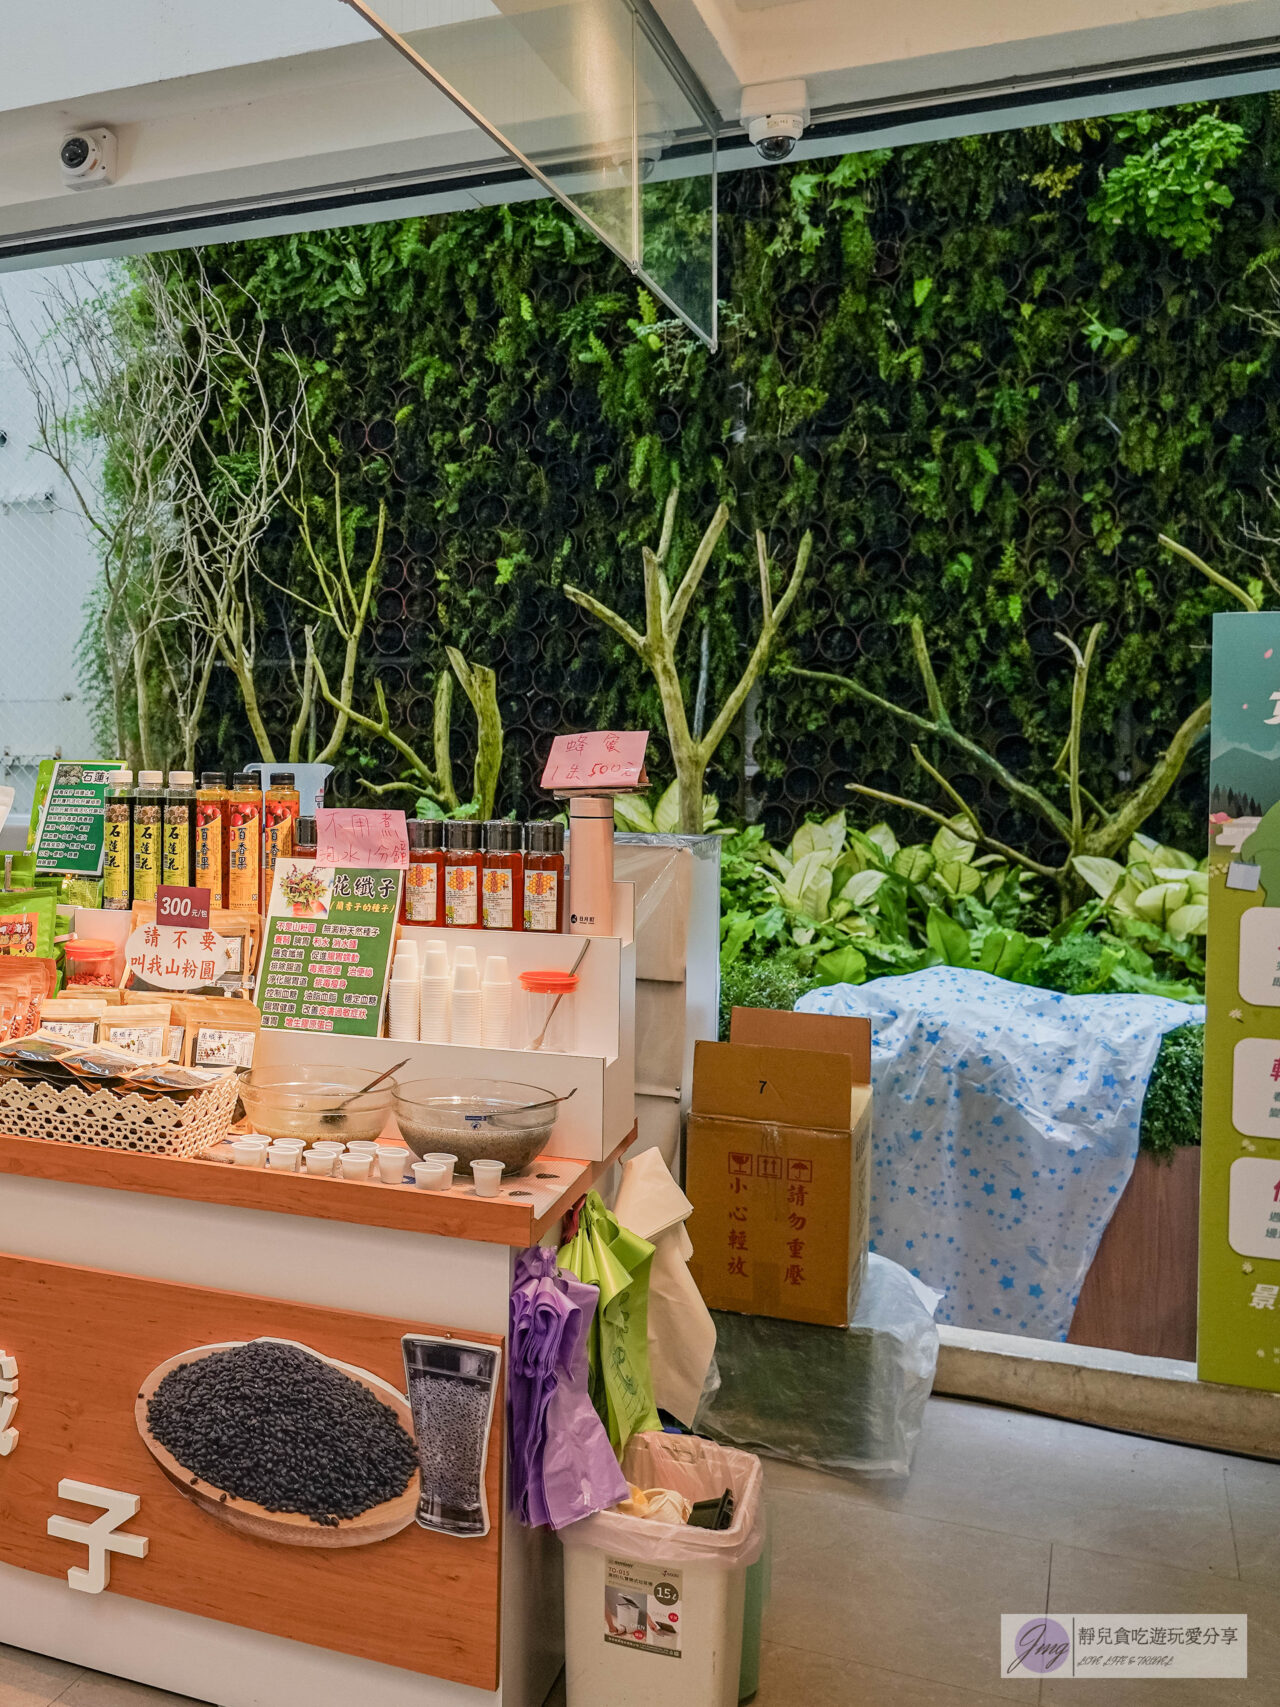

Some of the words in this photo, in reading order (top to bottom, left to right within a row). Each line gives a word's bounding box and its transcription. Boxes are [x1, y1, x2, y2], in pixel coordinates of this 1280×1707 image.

[325, 811, 400, 838] 不用煮
[108, 825, 121, 869] 石蓮花
[140, 827, 153, 871] 石蓮花
[168, 827, 180, 871] 石蓮花
[201, 828, 210, 870] 百香果
[237, 828, 248, 870] 百香果
[333, 874, 395, 899] 花纖子
[144, 926, 217, 952] 請不要
[131, 954, 216, 980] 叫我山粉圓
[758, 1080, 768, 1094] 7
[728, 1177, 749, 1278] 小心輕放
[784, 1184, 809, 1287] 請勿重壓
